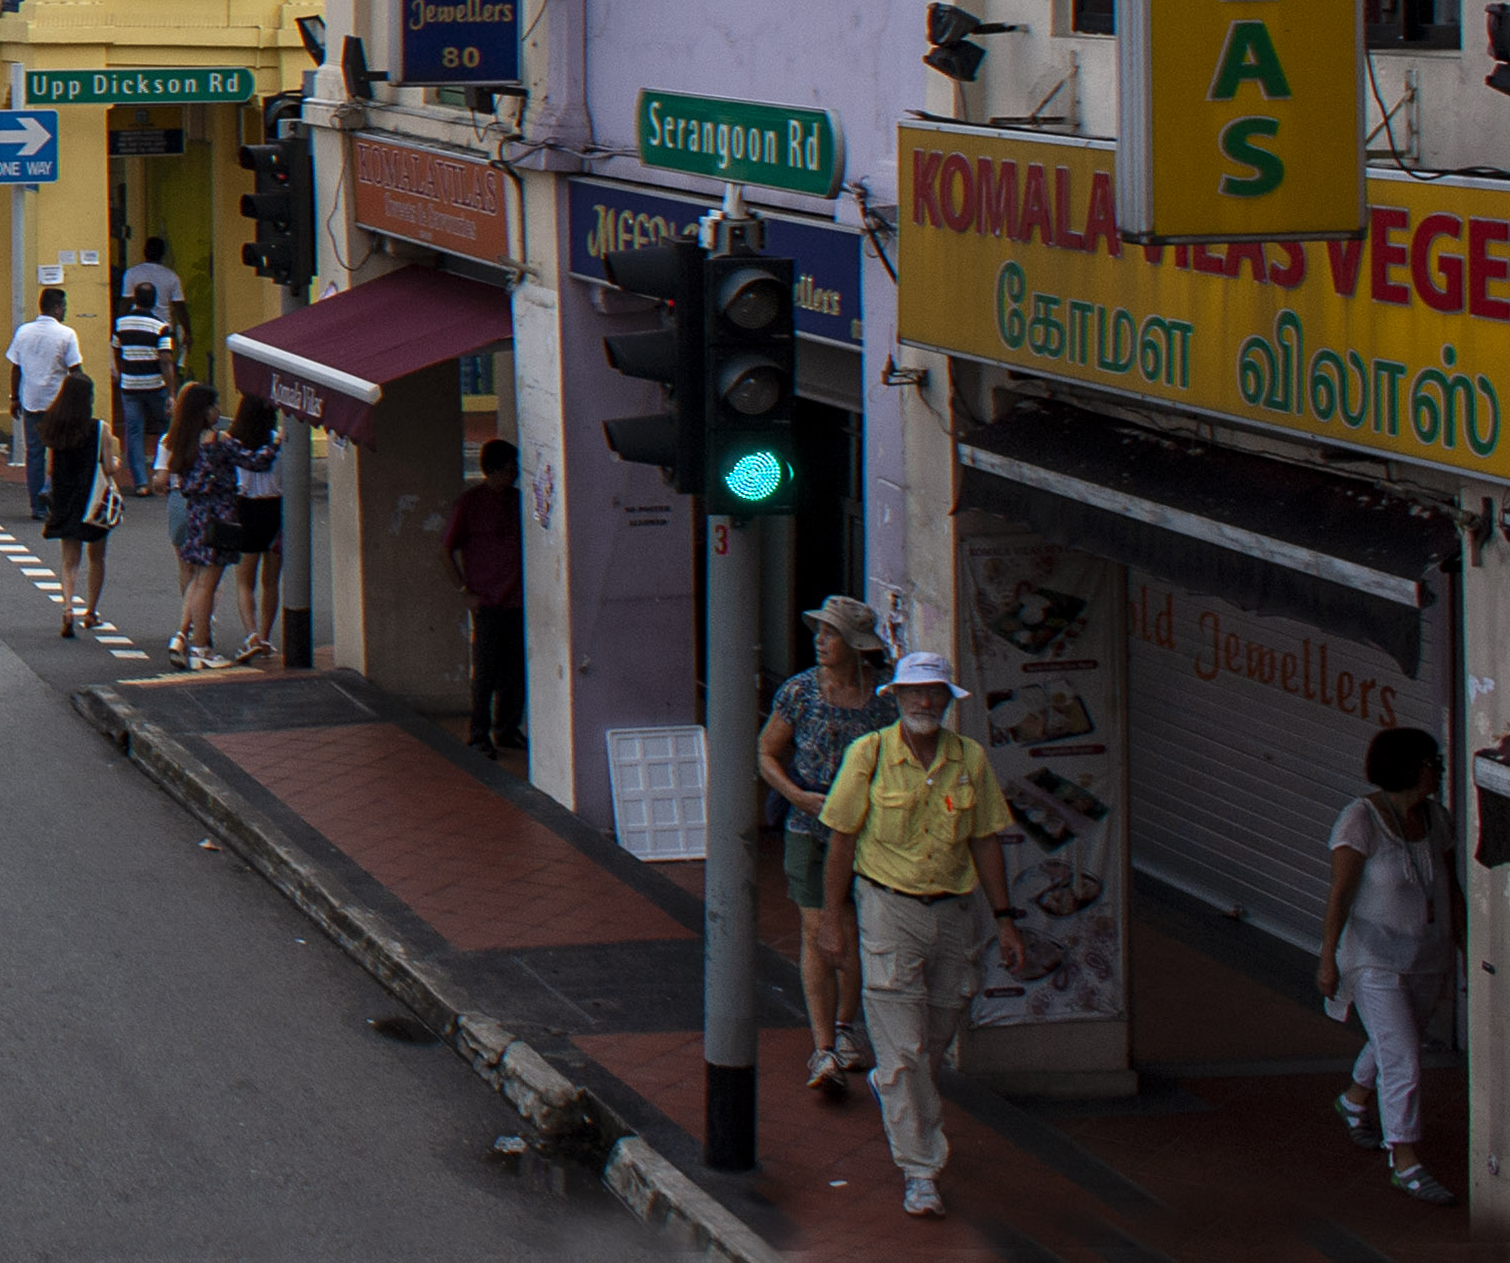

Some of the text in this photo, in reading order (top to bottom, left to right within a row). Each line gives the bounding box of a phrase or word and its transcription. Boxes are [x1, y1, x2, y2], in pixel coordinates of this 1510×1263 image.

[441, 45, 480, 69] 80
[32, 72, 240, 99] Upp Dickson Rd
[646, 101, 822, 172] Serangoon Rd
[26, 160, 54, 177] WAY
[912, 148, 1123, 259] KOMALA
[1236, 309, 1501, 459] விலாஸ்
[714, 524, 729, 555] 3
[1194, 609, 1399, 730] Jewellers
